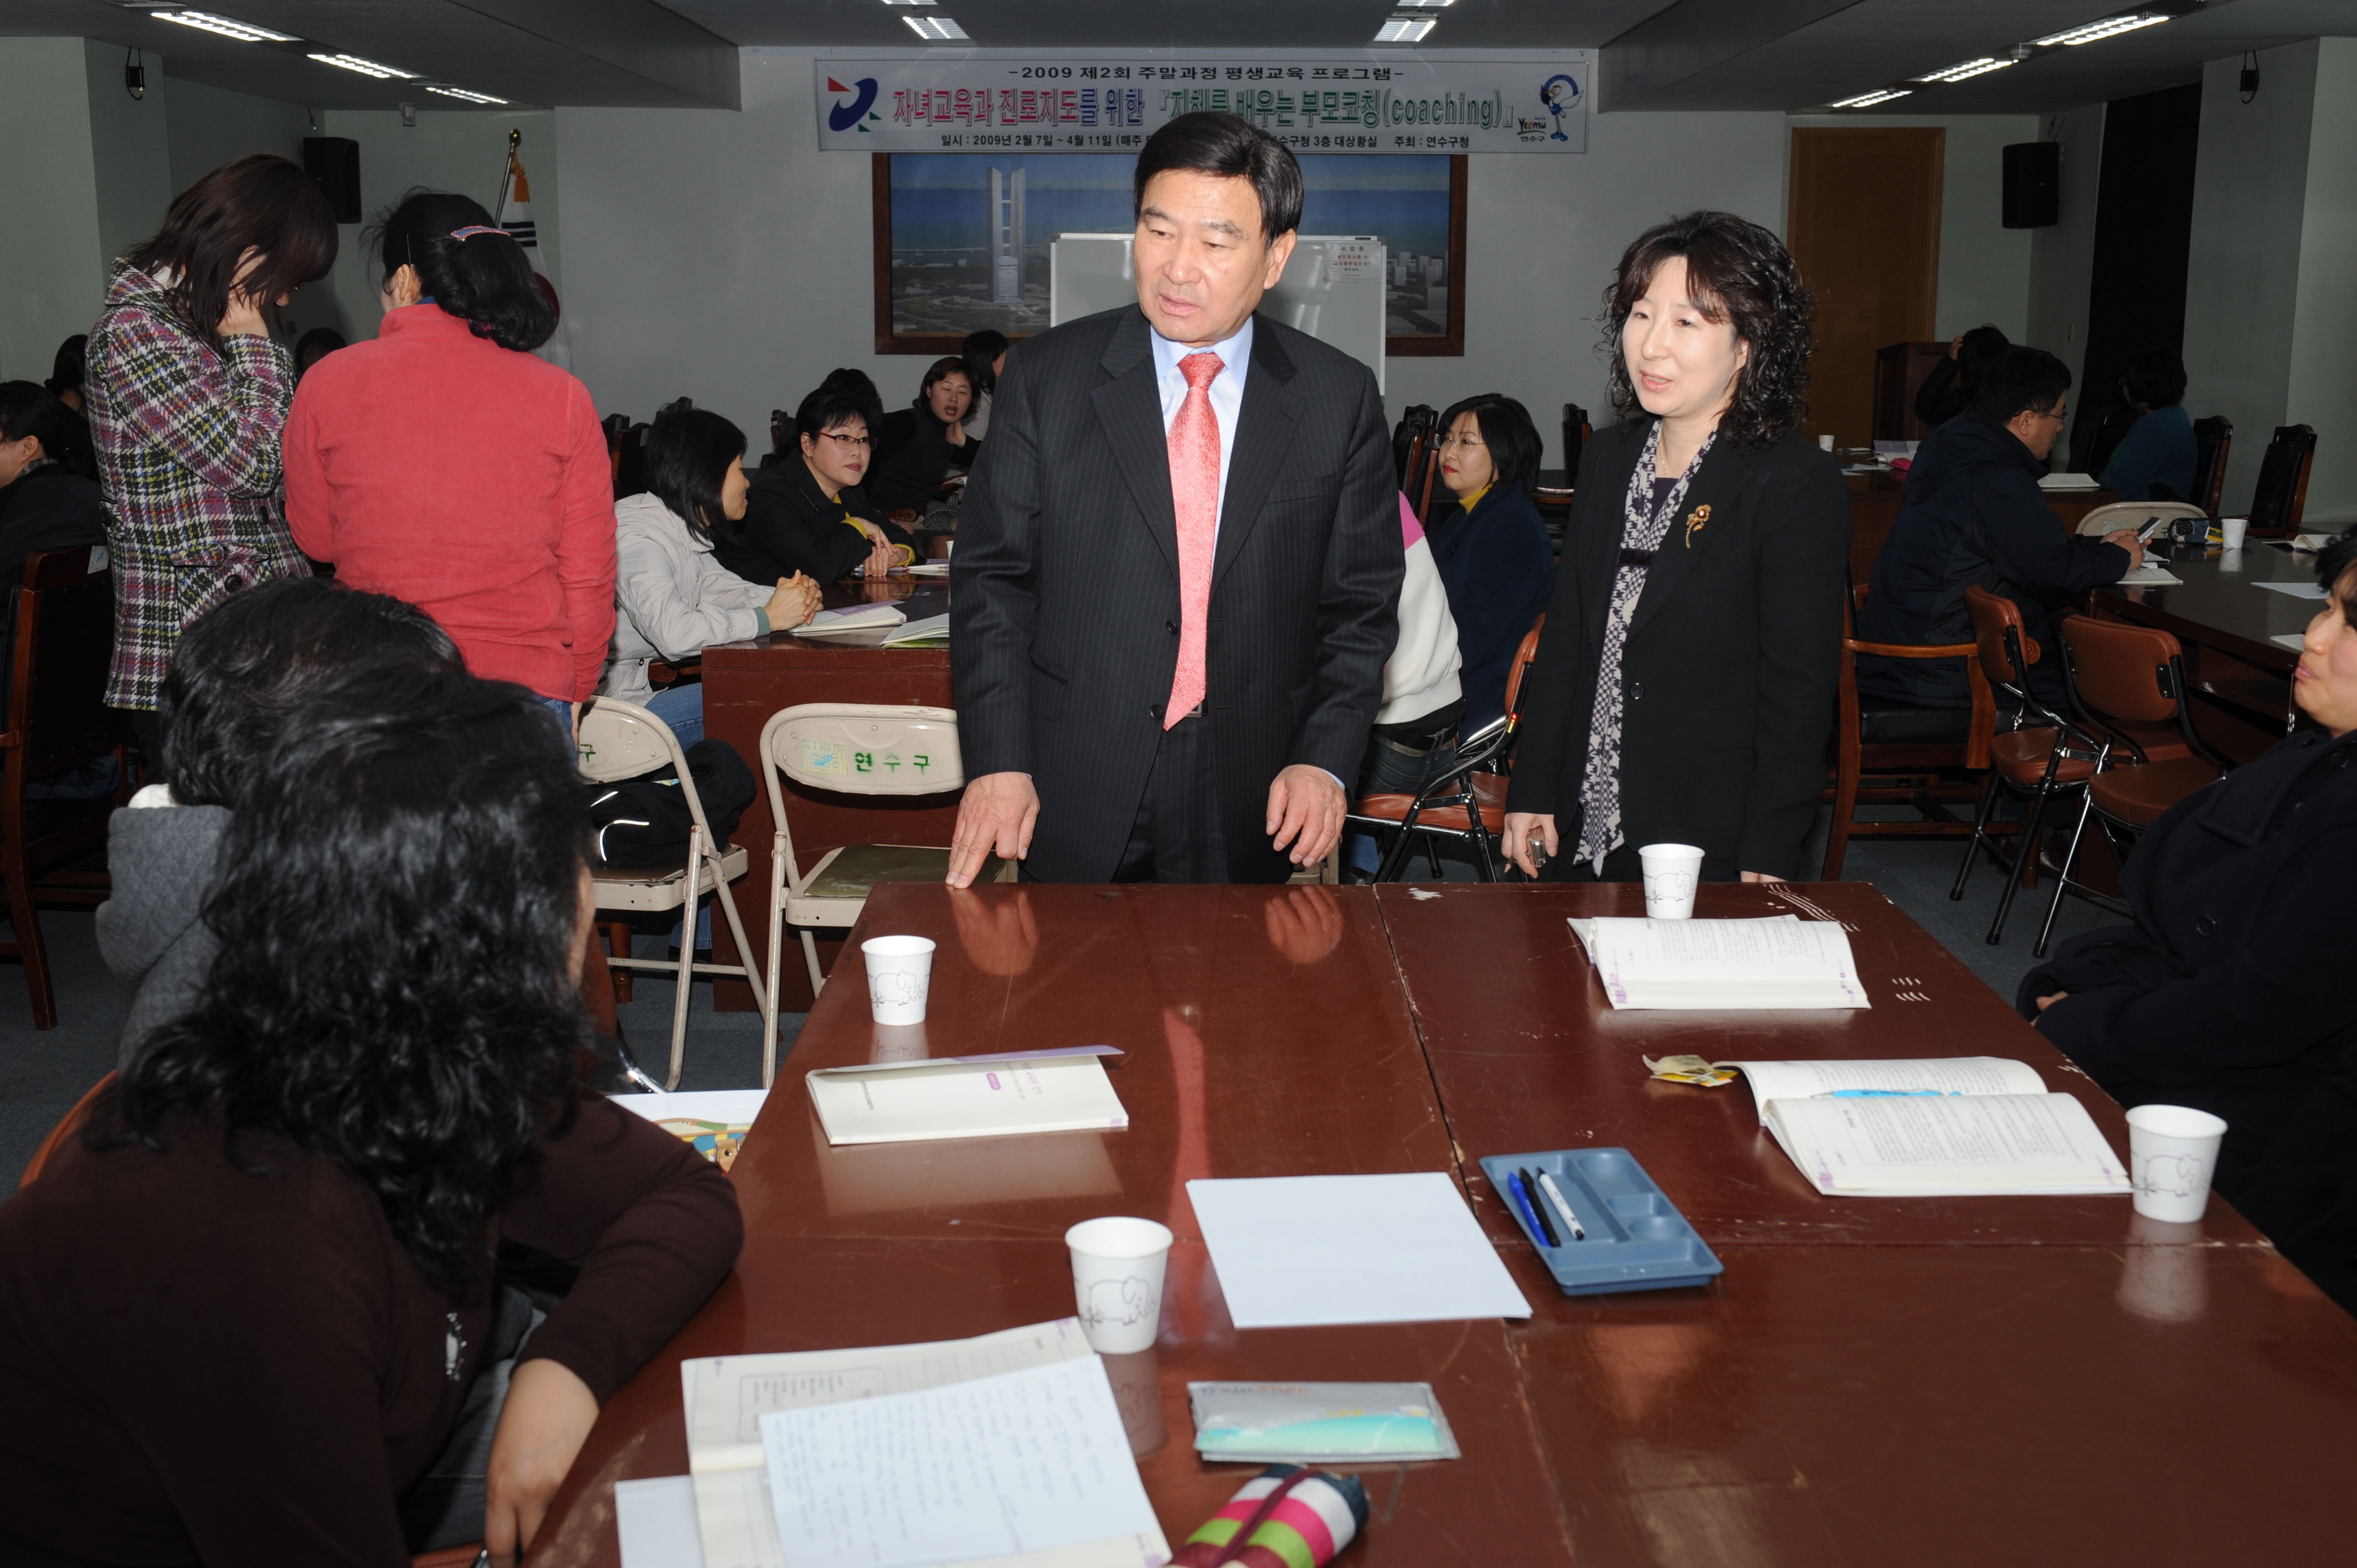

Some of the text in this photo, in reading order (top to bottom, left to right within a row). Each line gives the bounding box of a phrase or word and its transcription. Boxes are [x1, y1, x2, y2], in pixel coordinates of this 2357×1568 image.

[1079, 66, 1130, 80] 제2회
[1138, 66, 1217, 80] 주말과정
[1224, 67, 1305, 81] 평생교육
[893, 88, 994, 127] 자녀교육과
[999, 88, 1099, 127] 진로지도를
[1105, 88, 1145, 127] 위한
[1236, 89, 1295, 127] 배우는
[1517, 117, 1546, 133] Yeonsu
[941, 135, 963, 146] 일시
[973, 135, 1012, 146] 2009년
[1015, 135, 1032, 146] 2월
[1036, 135, 1053, 146] 7일
[1067, 135, 1084, 146] 4월
[1088, 135, 1112, 146] 11일
[1116, 135, 1143, 147] (매주
[1274, 135, 1310, 148] 수구청
[1313, 136, 1331, 148] 3층
[1334, 136, 1378, 148] 대상황실
[1394, 136, 1416, 148] 주최
[1427, 136, 1469, 148] 연수구청
[855, 752, 930, 775] 연수구
